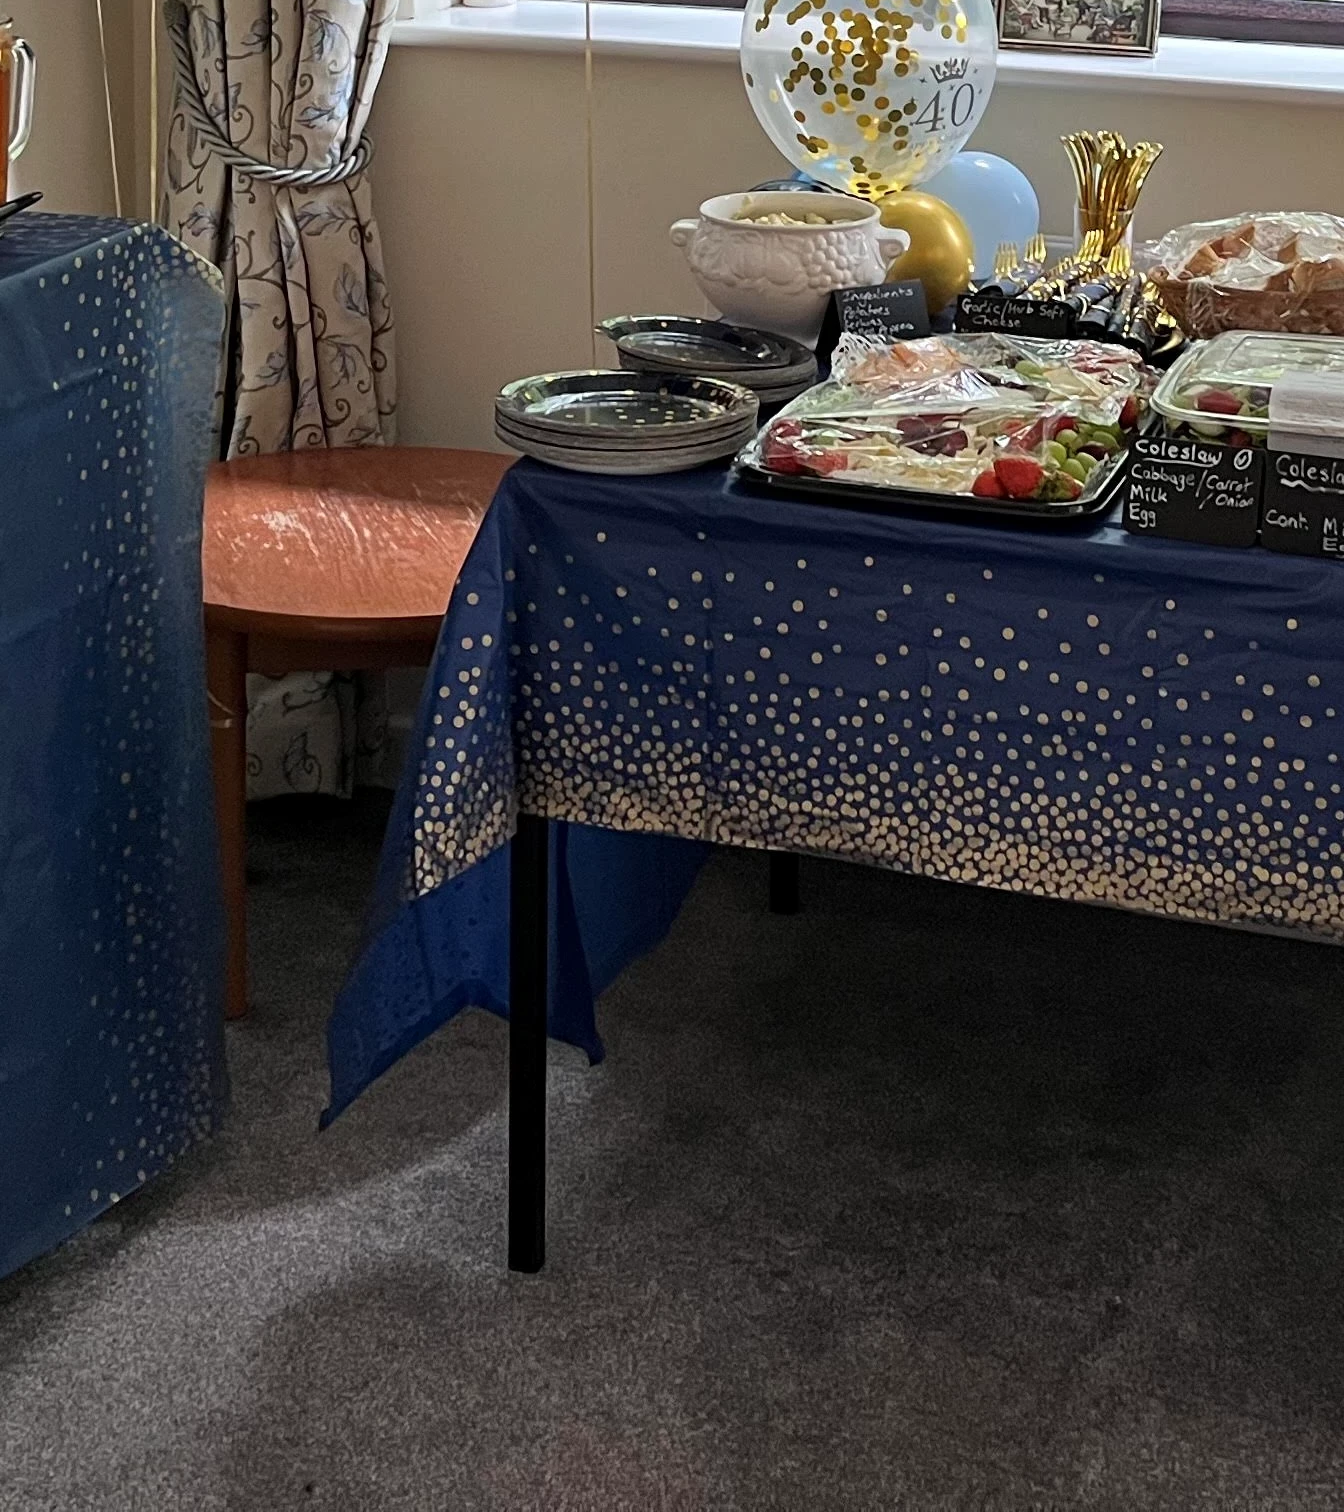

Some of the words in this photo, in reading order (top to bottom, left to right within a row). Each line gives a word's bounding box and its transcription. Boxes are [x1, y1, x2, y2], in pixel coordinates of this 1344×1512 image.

[911, 83, 975, 133] 40
[971, 314, 1022, 328] Cheese
[1135, 439, 1223, 466] Coleslaw
[1130, 483, 1168, 503] Milk
[1129, 502, 1157, 528] Egg
